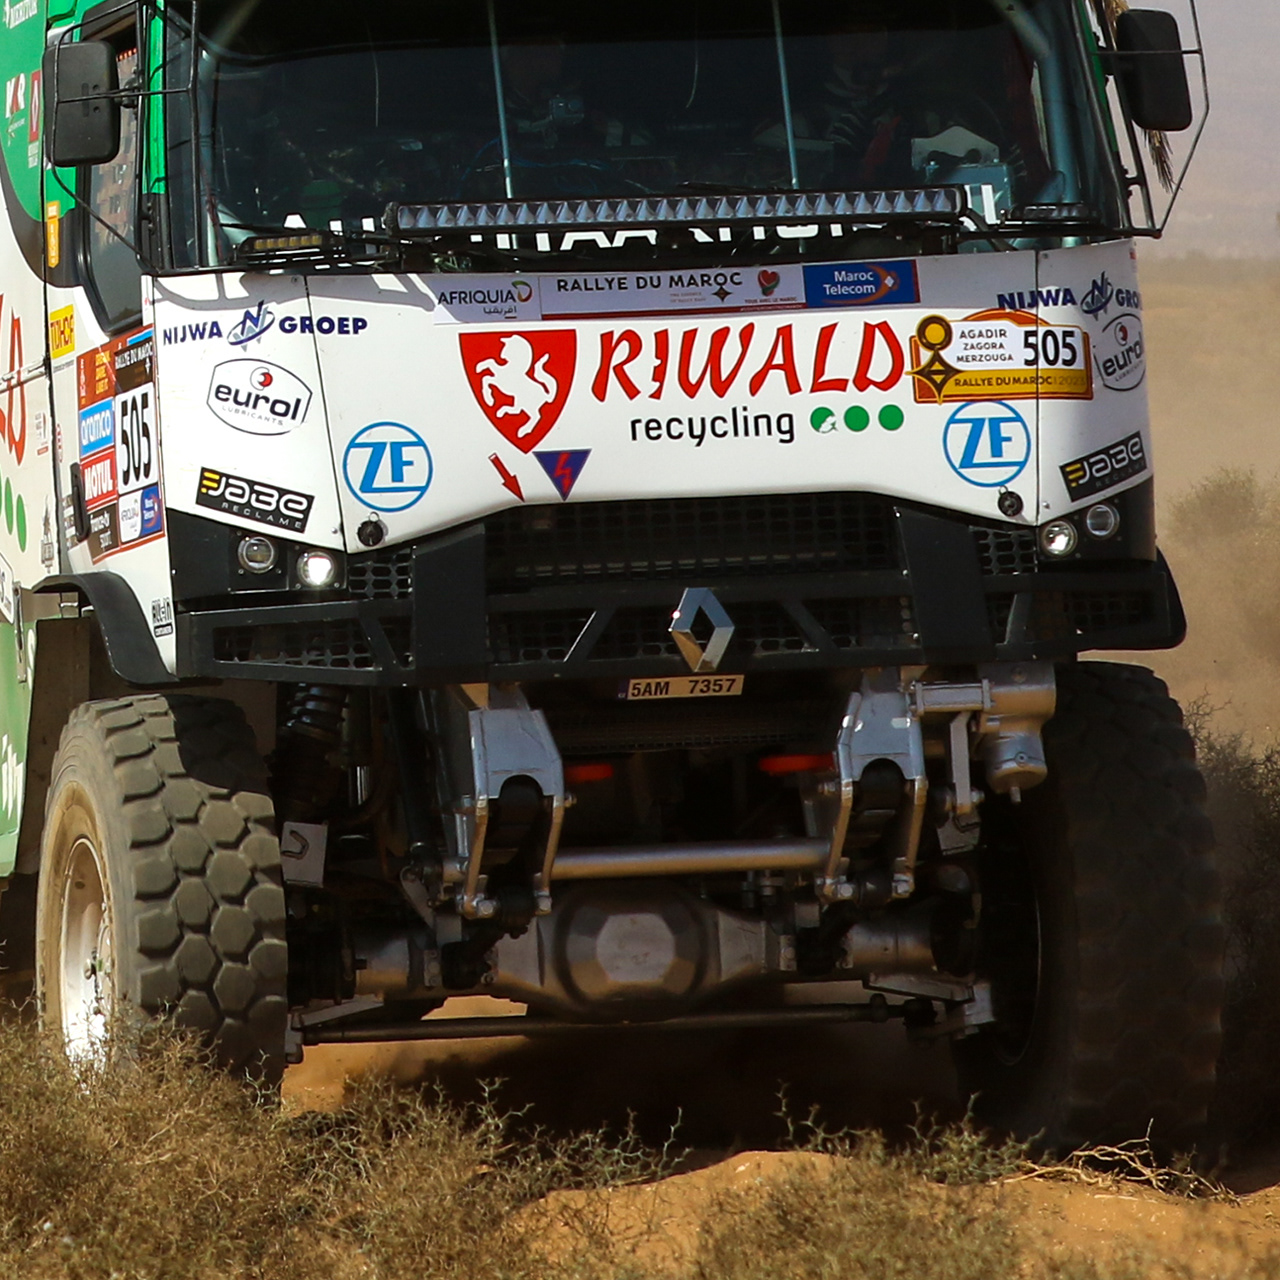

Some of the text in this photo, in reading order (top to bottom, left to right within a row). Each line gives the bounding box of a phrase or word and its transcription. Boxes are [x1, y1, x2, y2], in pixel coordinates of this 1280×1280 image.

[557, 271, 743, 292] RALLYE DU MAROC
[834, 270, 874, 283] Maroc
[437, 291, 517, 306] AFRIQUIA
[823, 283, 876, 297] Telecom
[997, 288, 1077, 311] NIJWA
[163, 321, 223, 346] NIJWA
[278, 316, 368, 336] GROEP
[959, 328, 1008, 339] AGADIR
[963, 342, 1005, 351] ZAGORA
[1023, 329, 1077, 367] 505
[591, 320, 905, 404] RIWALD
[956, 353, 1014, 363] MERZOUGA
[954, 377, 993, 388] RALLYE
[996, 377, 1010, 386] DU
[1011, 376, 1053, 386] MAROC
[214, 383, 301, 421] eurol
[222, 405, 284, 426] LUBRICANTS
[630, 405, 795, 447] recycling
[80, 409, 112, 446] aramco
[120, 392, 152, 486] 505
[84, 459, 113, 501] MOTUL
[221, 502, 302, 529] RECLAME
[631, 678, 737, 697] 5AM 7357
